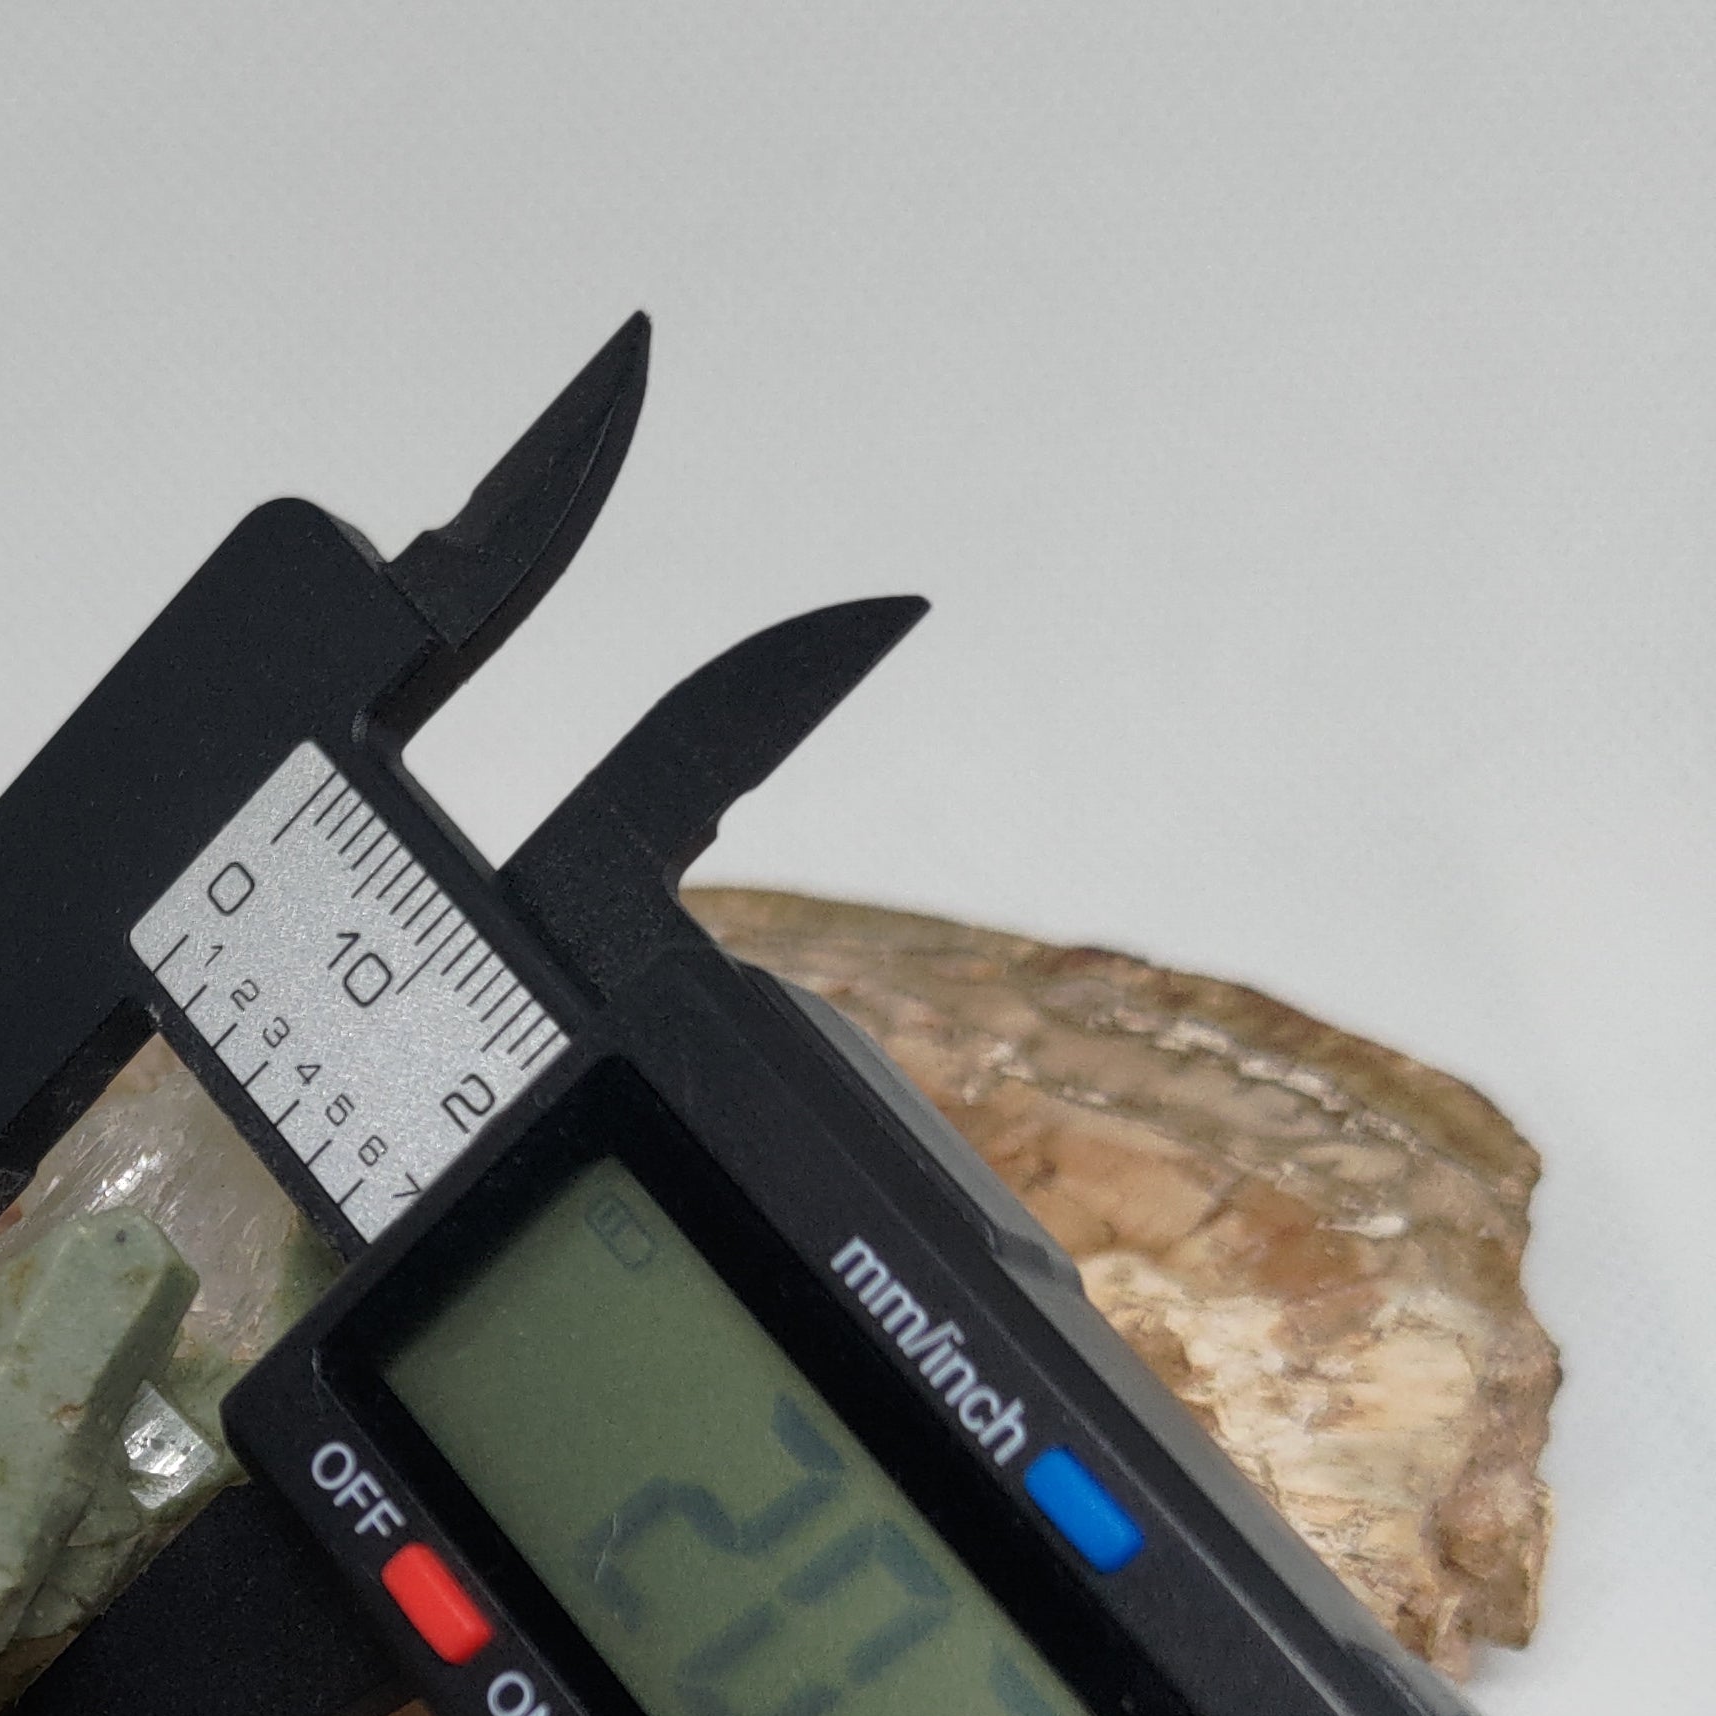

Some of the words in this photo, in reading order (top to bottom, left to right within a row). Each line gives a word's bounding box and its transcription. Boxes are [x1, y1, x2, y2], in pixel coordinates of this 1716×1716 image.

[206, 860, 256, 916] 0
[327, 931, 394, 1008] 10
[204, 944, 224, 967] 1
[228, 978, 261, 1012] 2
[261, 1015, 291, 1049] 3
[295, 1062, 322, 1086] 4
[324, 1092, 355, 1127] 5
[356, 1133, 389, 1168] 6
[392, 1172, 422, 1200] 7
[829, 1234, 1031, 1466] mm/inch
[310, 1440, 406, 1538] OFF
